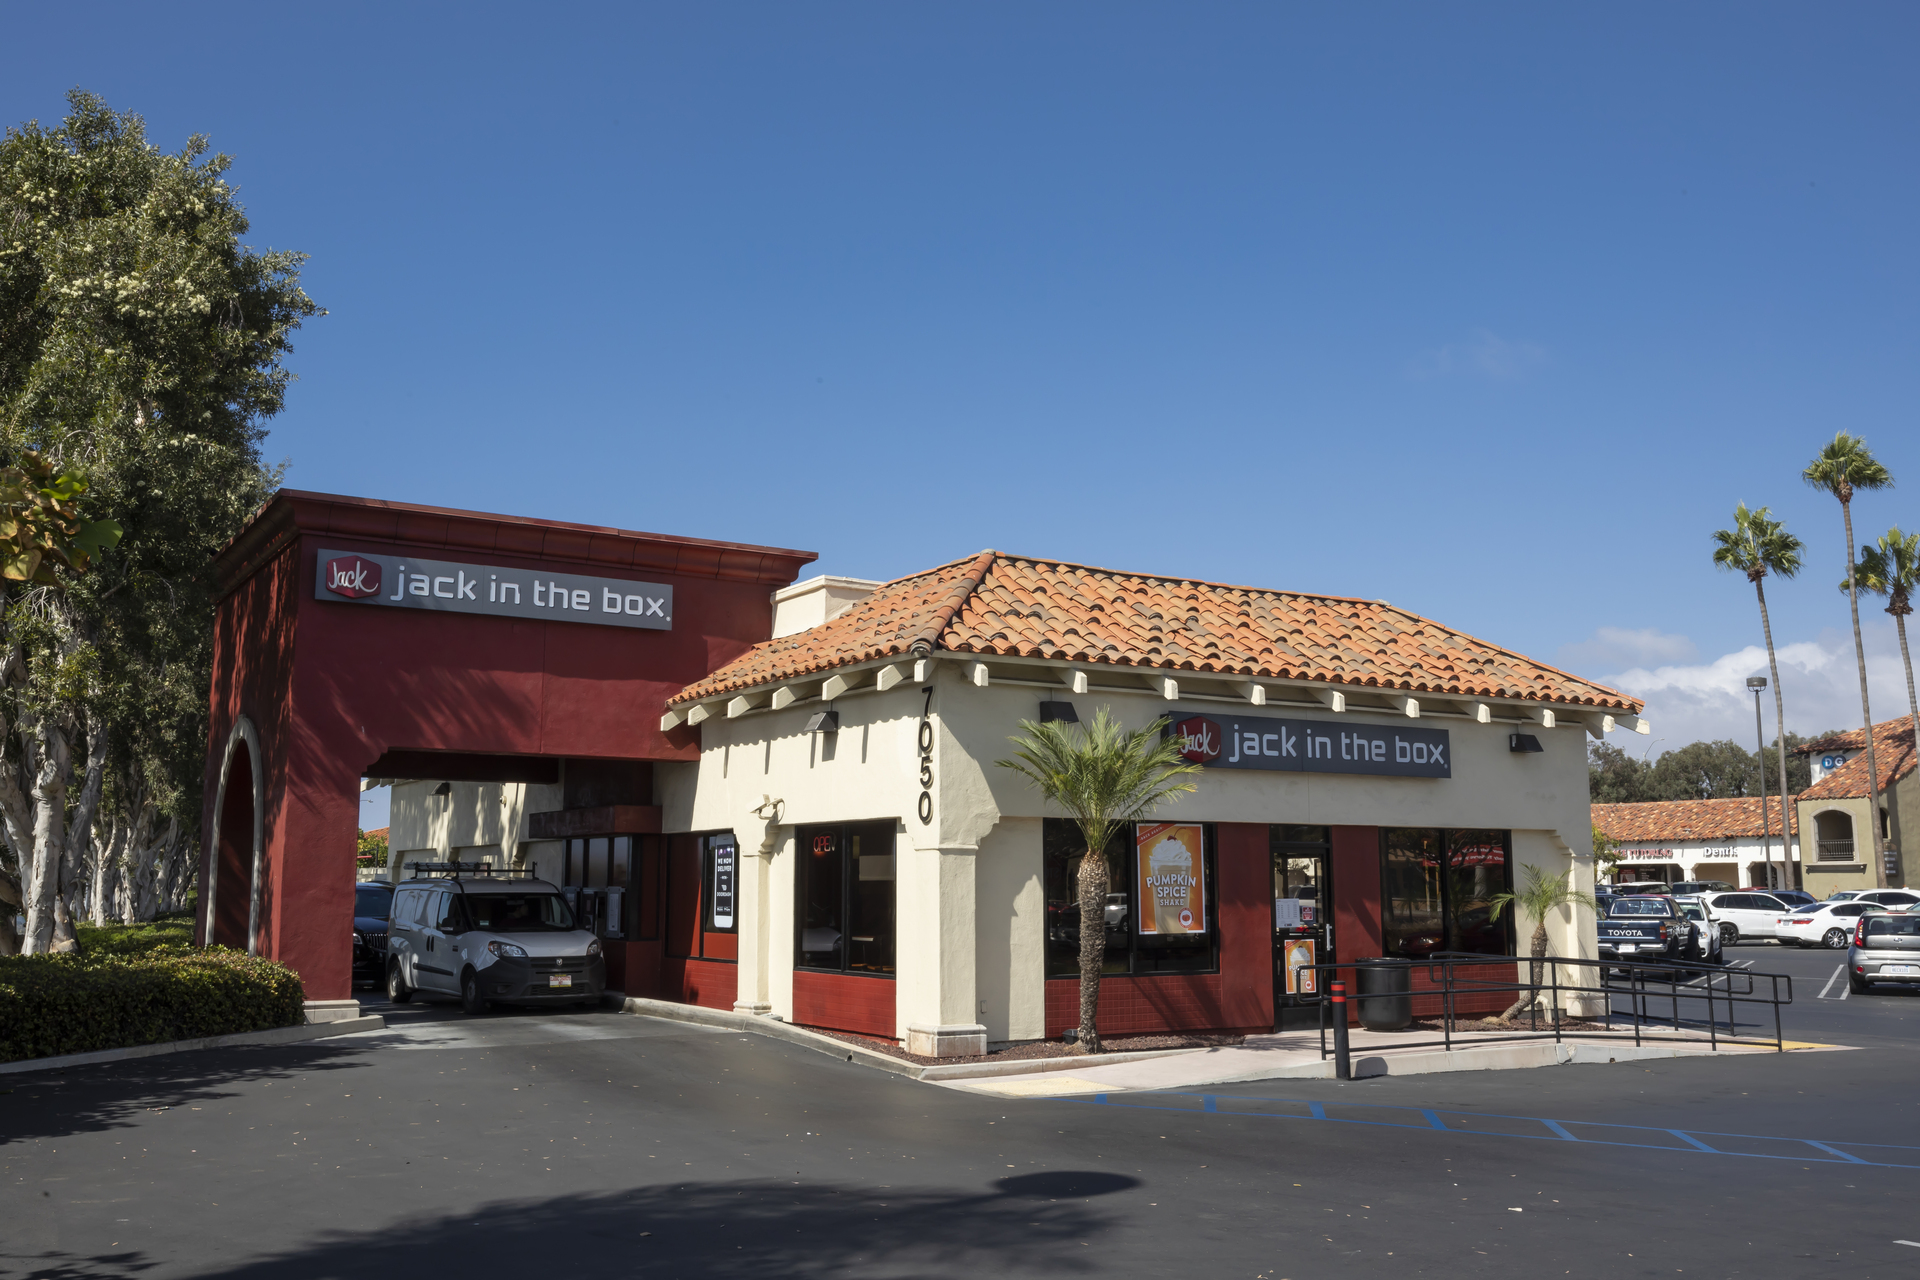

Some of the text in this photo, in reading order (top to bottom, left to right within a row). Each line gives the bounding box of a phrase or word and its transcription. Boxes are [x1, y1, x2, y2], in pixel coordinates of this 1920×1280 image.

[329, 560, 379, 592] Jack
[390, 565, 665, 618] jack in the box
[1180, 722, 1220, 756] Jack
[1228, 723, 1444, 765] jack in the box
[918, 685, 933, 824] 7050
[813, 835, 835, 852] OPEN
[1628, 848, 1672, 857] TUTORING
[1146, 873, 1196, 888] PUMPKIN
[1157, 886, 1187, 897] SPICE
[1607, 929, 1643, 937] TOYOTA
